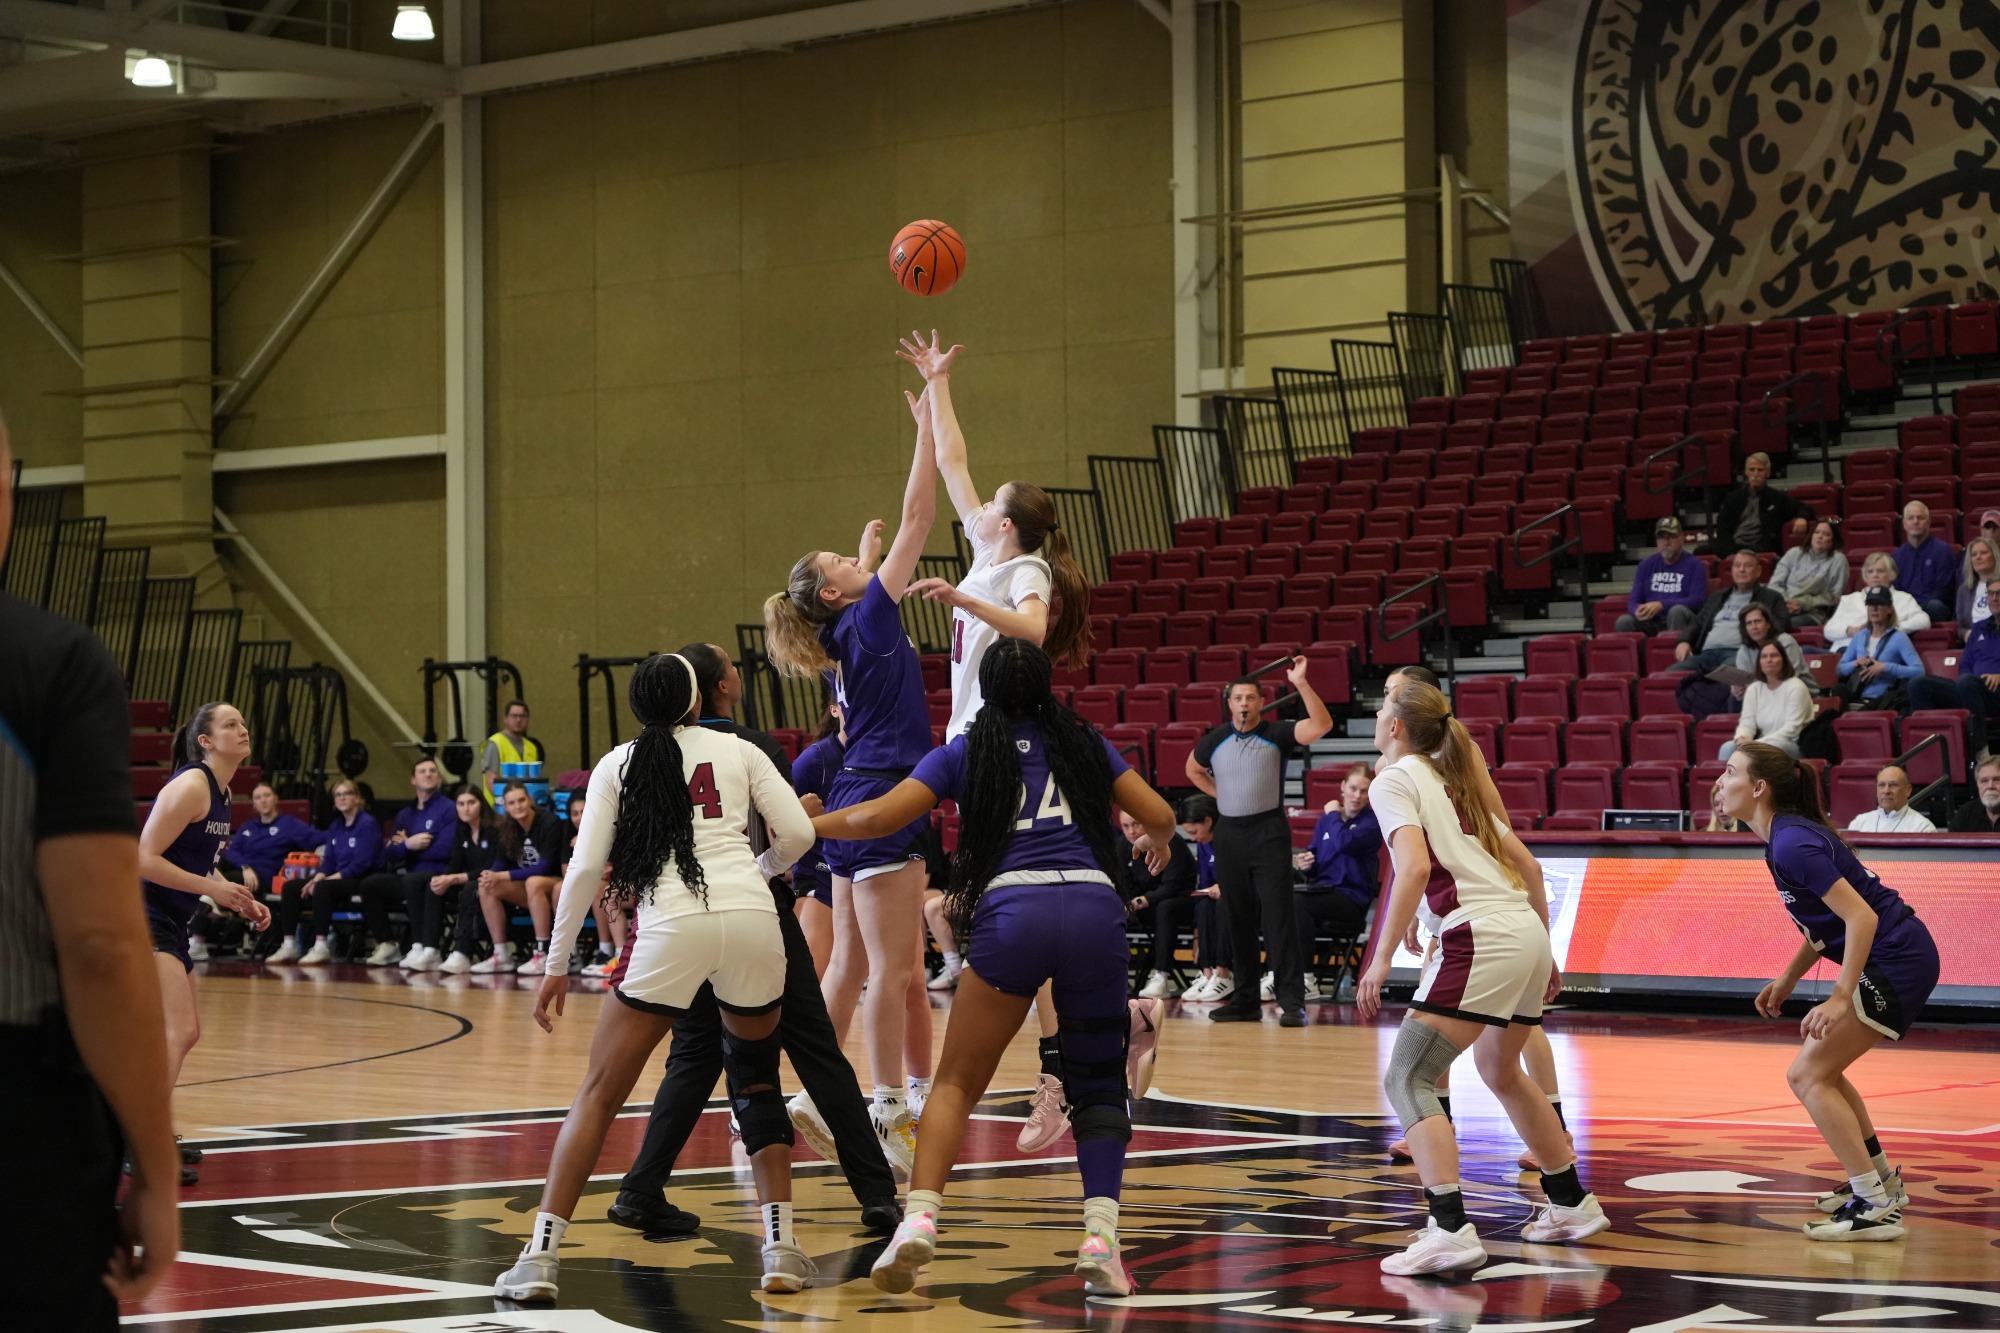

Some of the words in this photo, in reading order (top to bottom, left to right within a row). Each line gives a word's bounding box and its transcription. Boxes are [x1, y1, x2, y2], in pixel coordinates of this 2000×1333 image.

[1651, 571, 1685, 582] HOLY
[1651, 581, 1682, 593] CROSS
[1561, 985, 1611, 993] AKTRONICS
